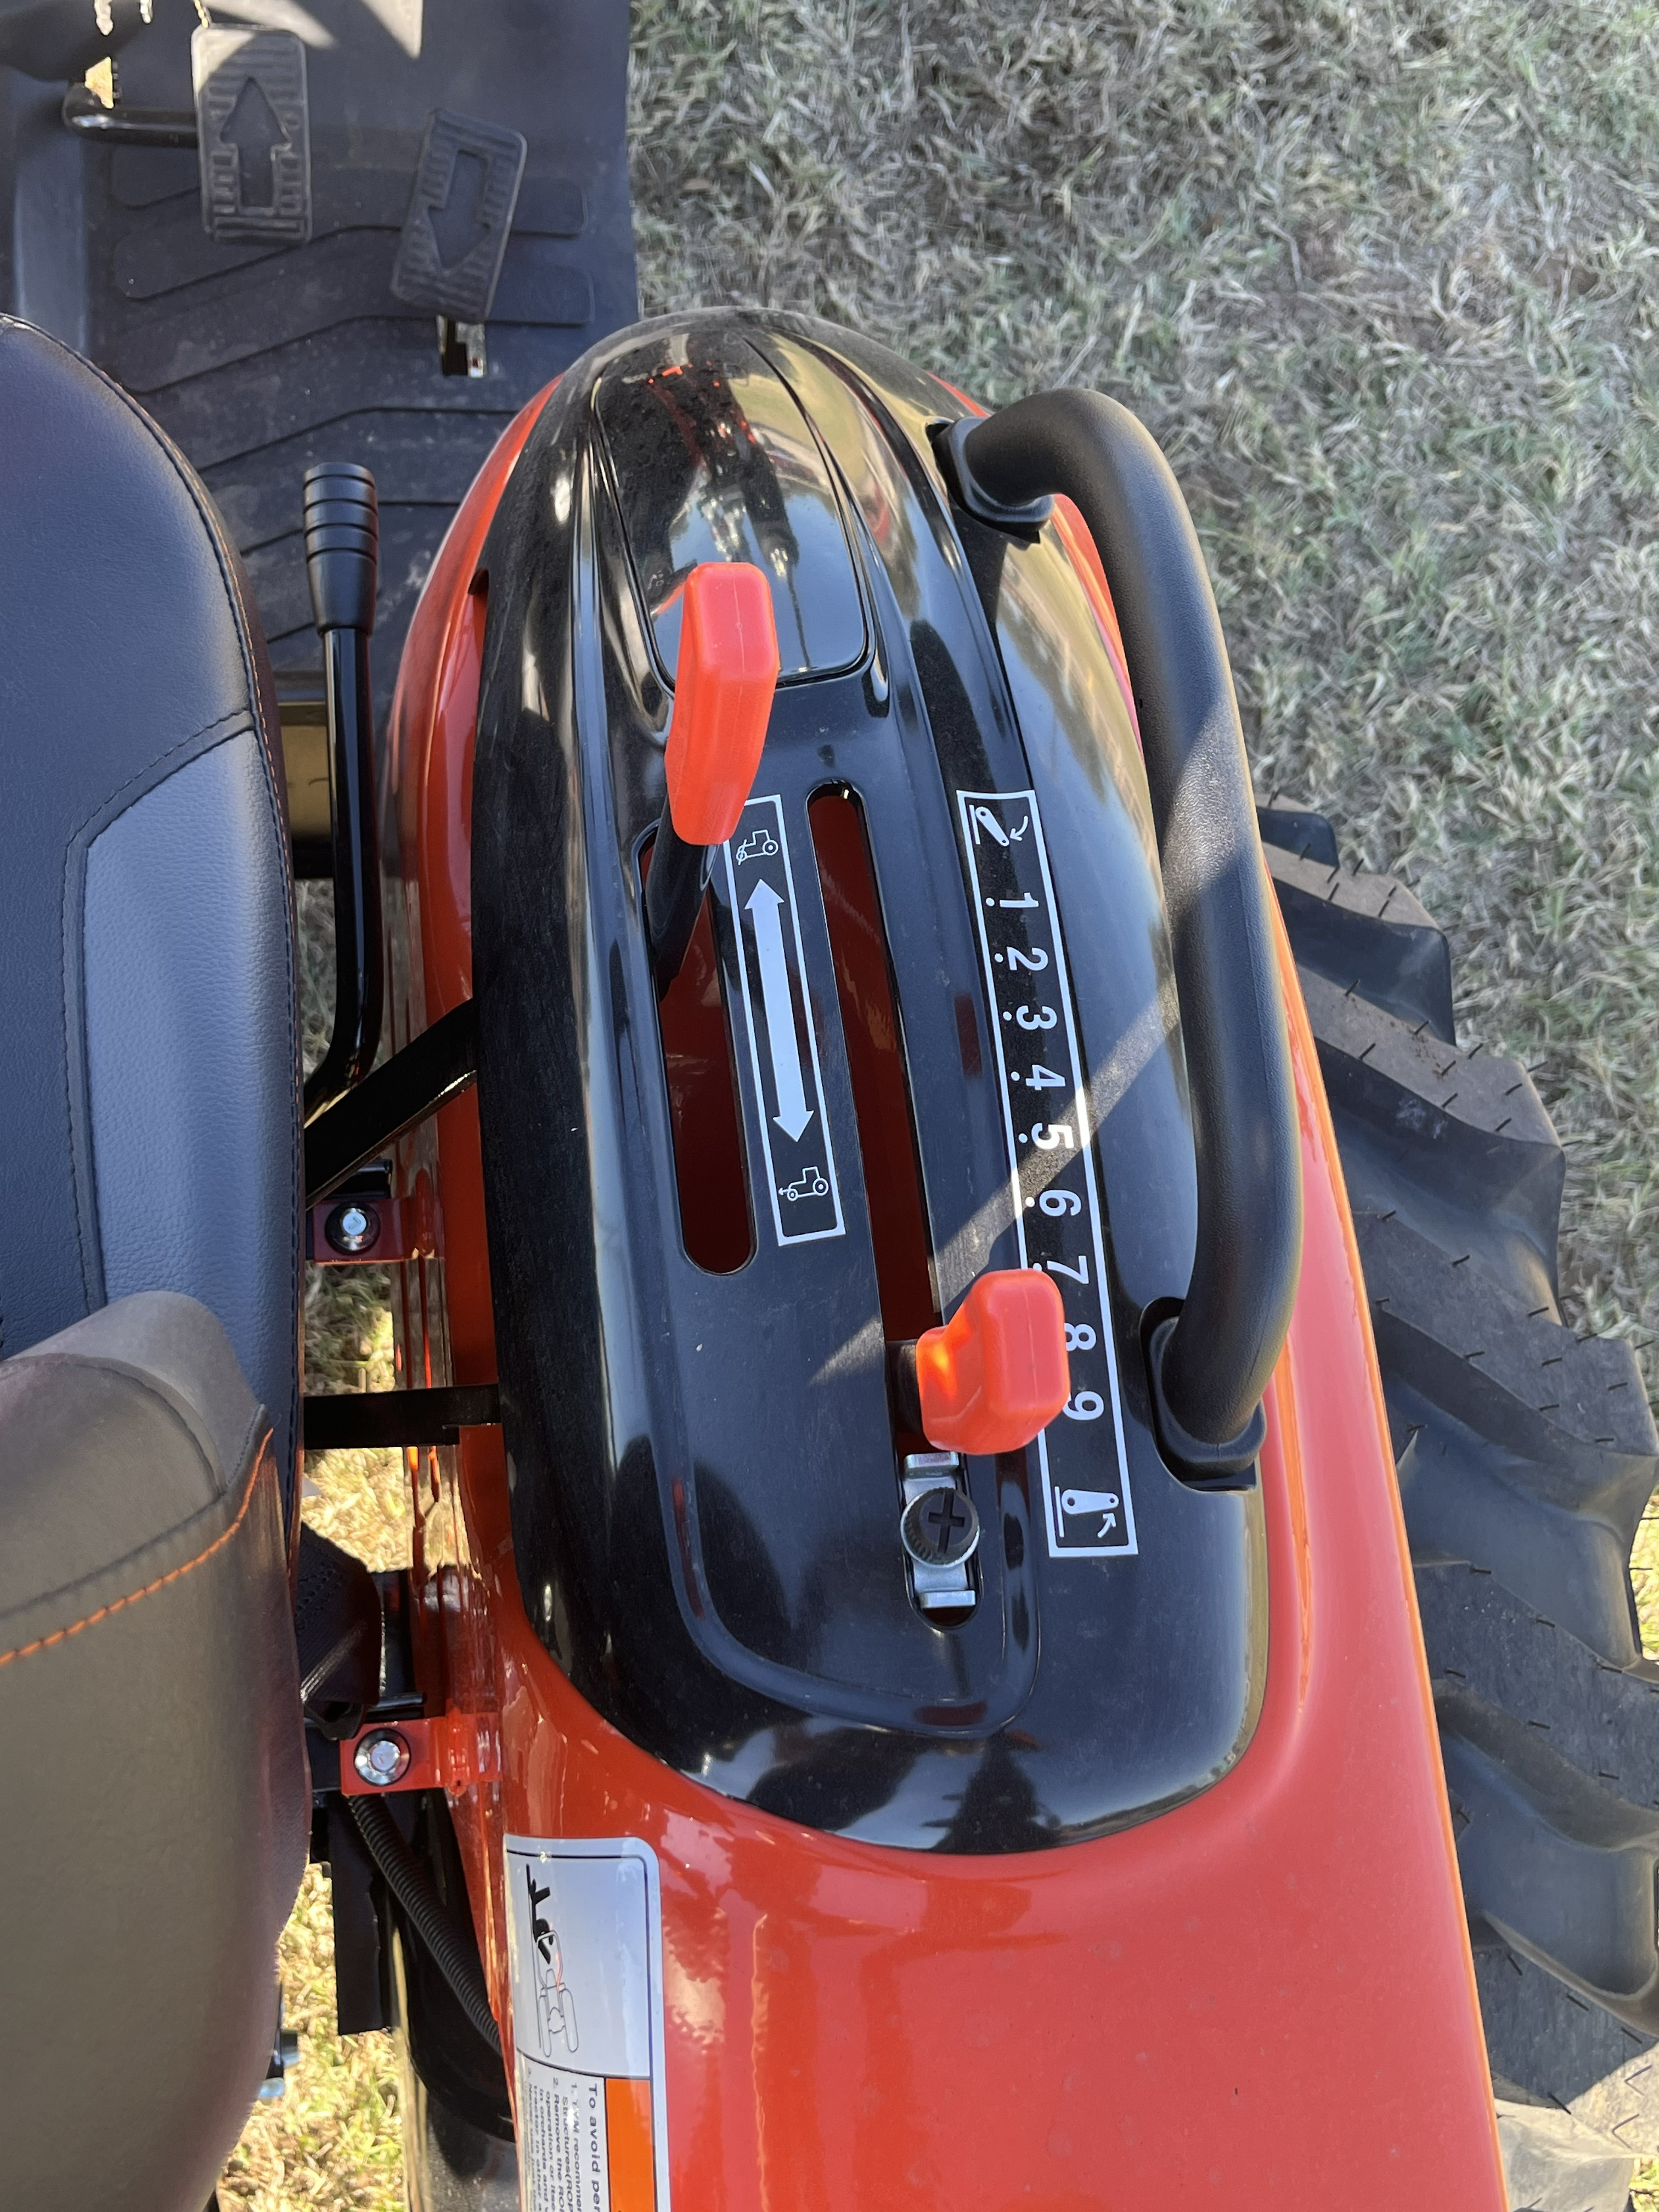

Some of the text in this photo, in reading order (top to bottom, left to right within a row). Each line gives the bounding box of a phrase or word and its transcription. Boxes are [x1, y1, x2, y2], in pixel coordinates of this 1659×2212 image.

[999, 891, 1104, 1421] 1 2 3 4 5 6 7 8 9
[589, 2084, 597, 2108] To
[590, 2116, 601, 2173] avoid
